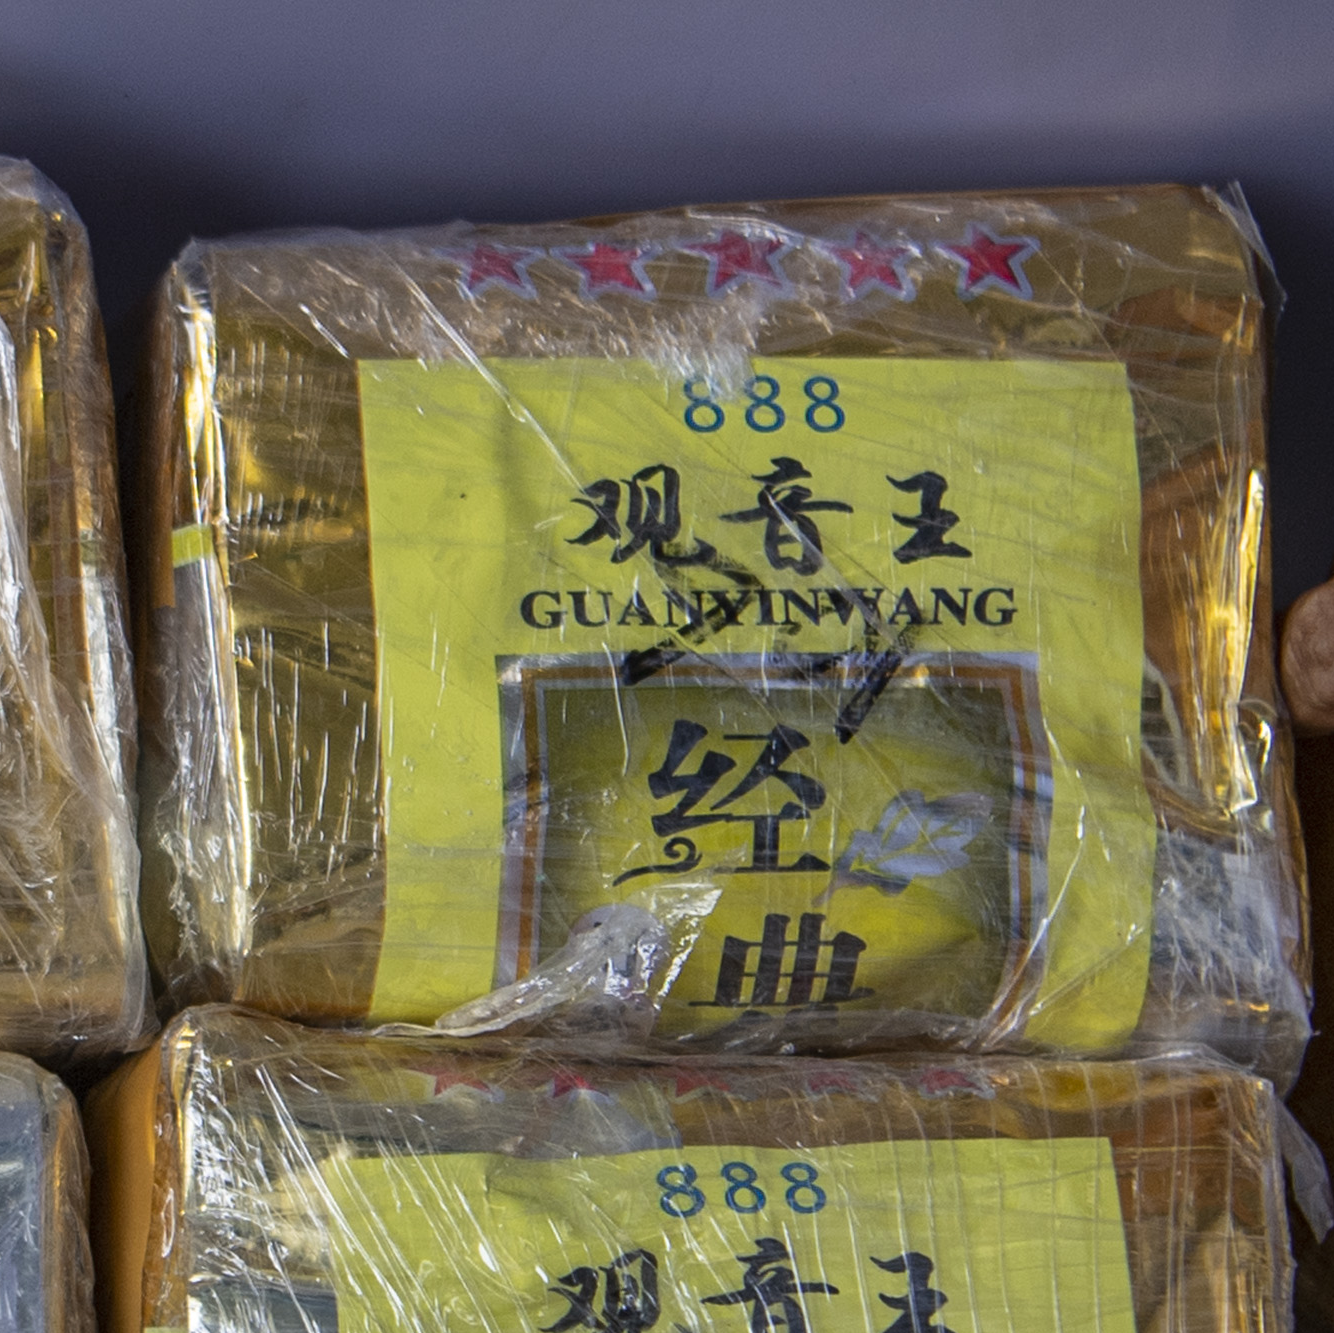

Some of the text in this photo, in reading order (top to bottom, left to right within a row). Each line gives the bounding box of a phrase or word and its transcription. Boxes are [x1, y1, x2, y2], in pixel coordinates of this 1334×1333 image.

[684, 373, 847, 434] 888
[566, 456, 973, 575] 观音王
[519, 586, 1017, 630] GUANYINWANG
[655, 1161, 828, 1219] 888
